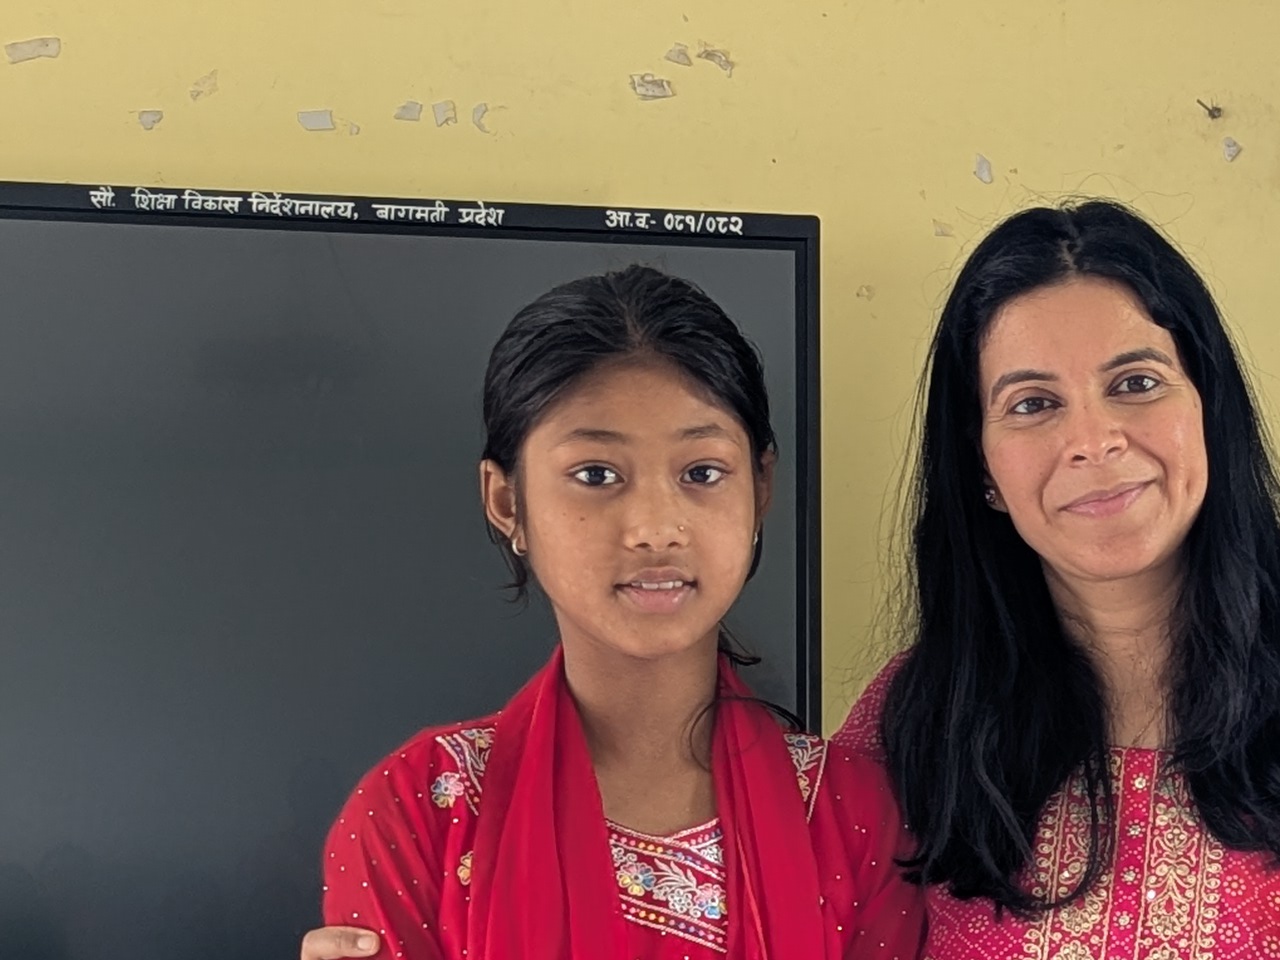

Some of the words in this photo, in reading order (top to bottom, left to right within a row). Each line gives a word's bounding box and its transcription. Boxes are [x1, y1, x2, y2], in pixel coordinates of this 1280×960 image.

[131, 187, 178, 211] शिक्षा
[181, 189, 243, 214] विकास
[371, 200, 450, 223] बागमती
[458, 200, 505, 226] प्रदेश
[664, 213, 743, 235] ०८१/०८२
